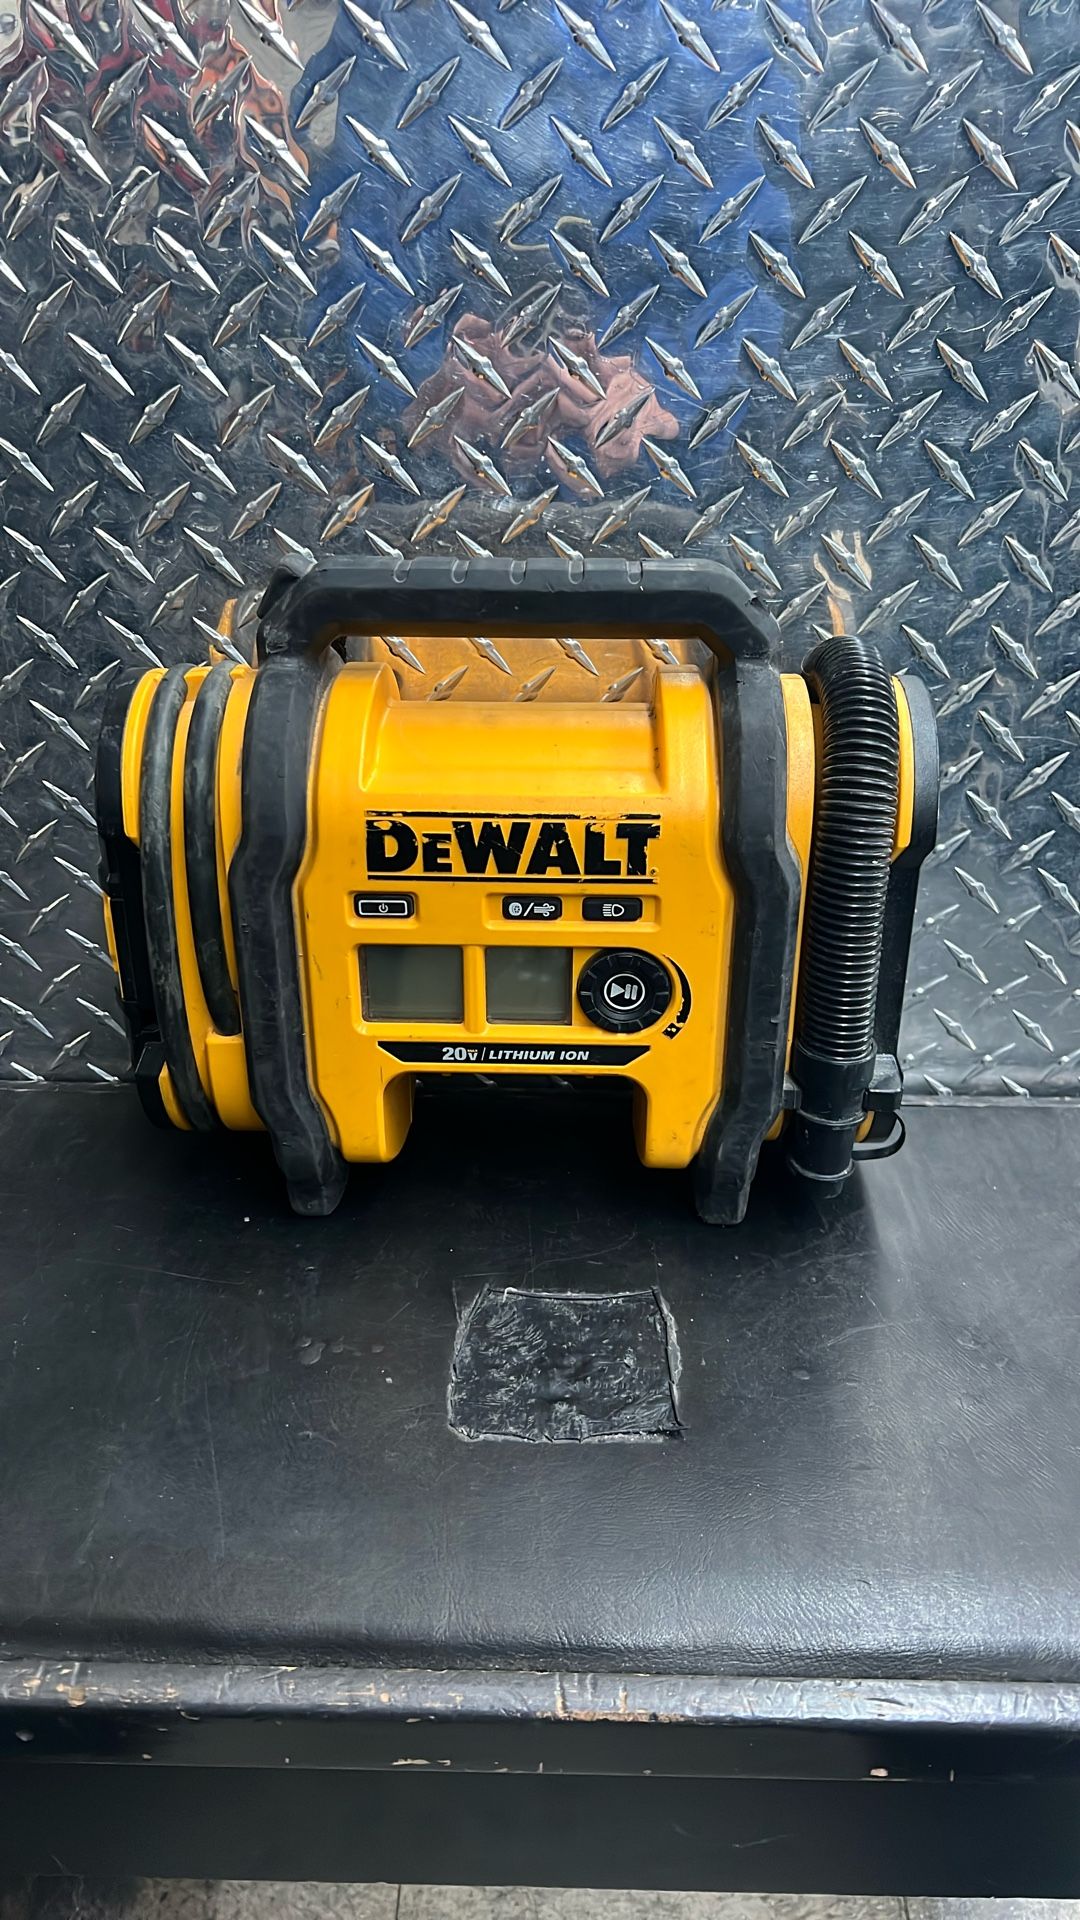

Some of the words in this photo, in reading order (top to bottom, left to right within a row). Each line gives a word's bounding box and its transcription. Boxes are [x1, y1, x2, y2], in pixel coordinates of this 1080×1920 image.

[366, 819, 660, 875] DEWALT
[488, 1050, 555, 1061] LITHIUM
[559, 1051, 589, 1061] ION
